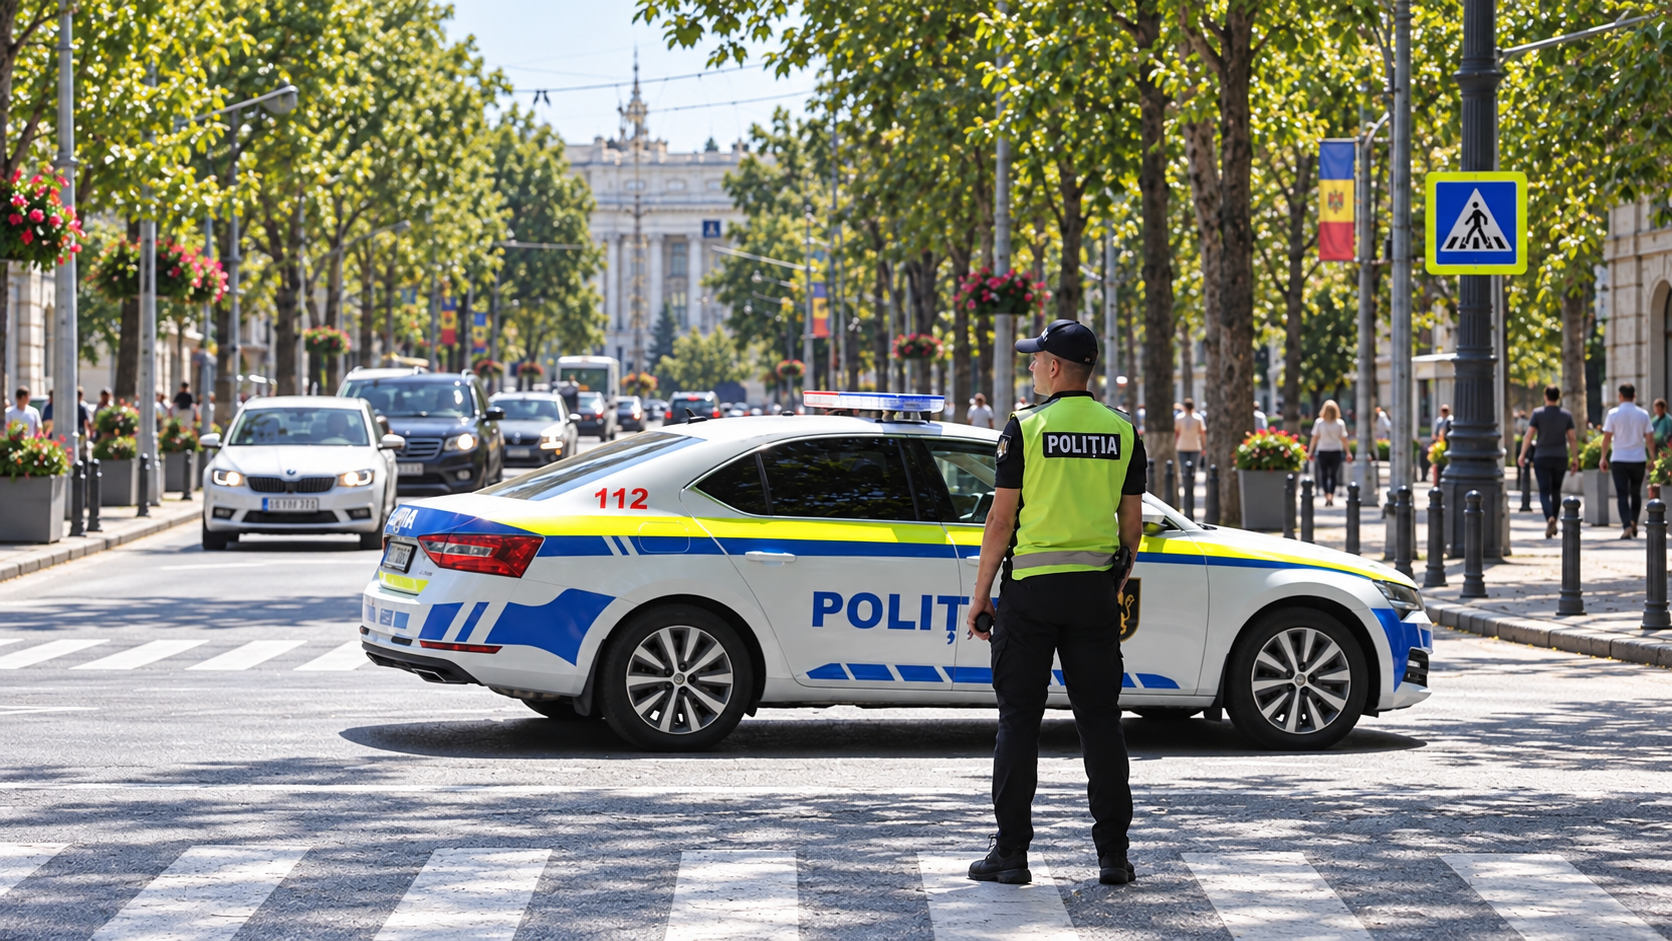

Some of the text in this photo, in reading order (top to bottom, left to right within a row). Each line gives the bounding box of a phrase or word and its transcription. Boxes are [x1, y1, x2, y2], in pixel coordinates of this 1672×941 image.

[1047, 434, 1118, 458] POLIȚIA
[594, 487, 649, 510] 112
[811, 590, 1000, 645] POLIȚ
